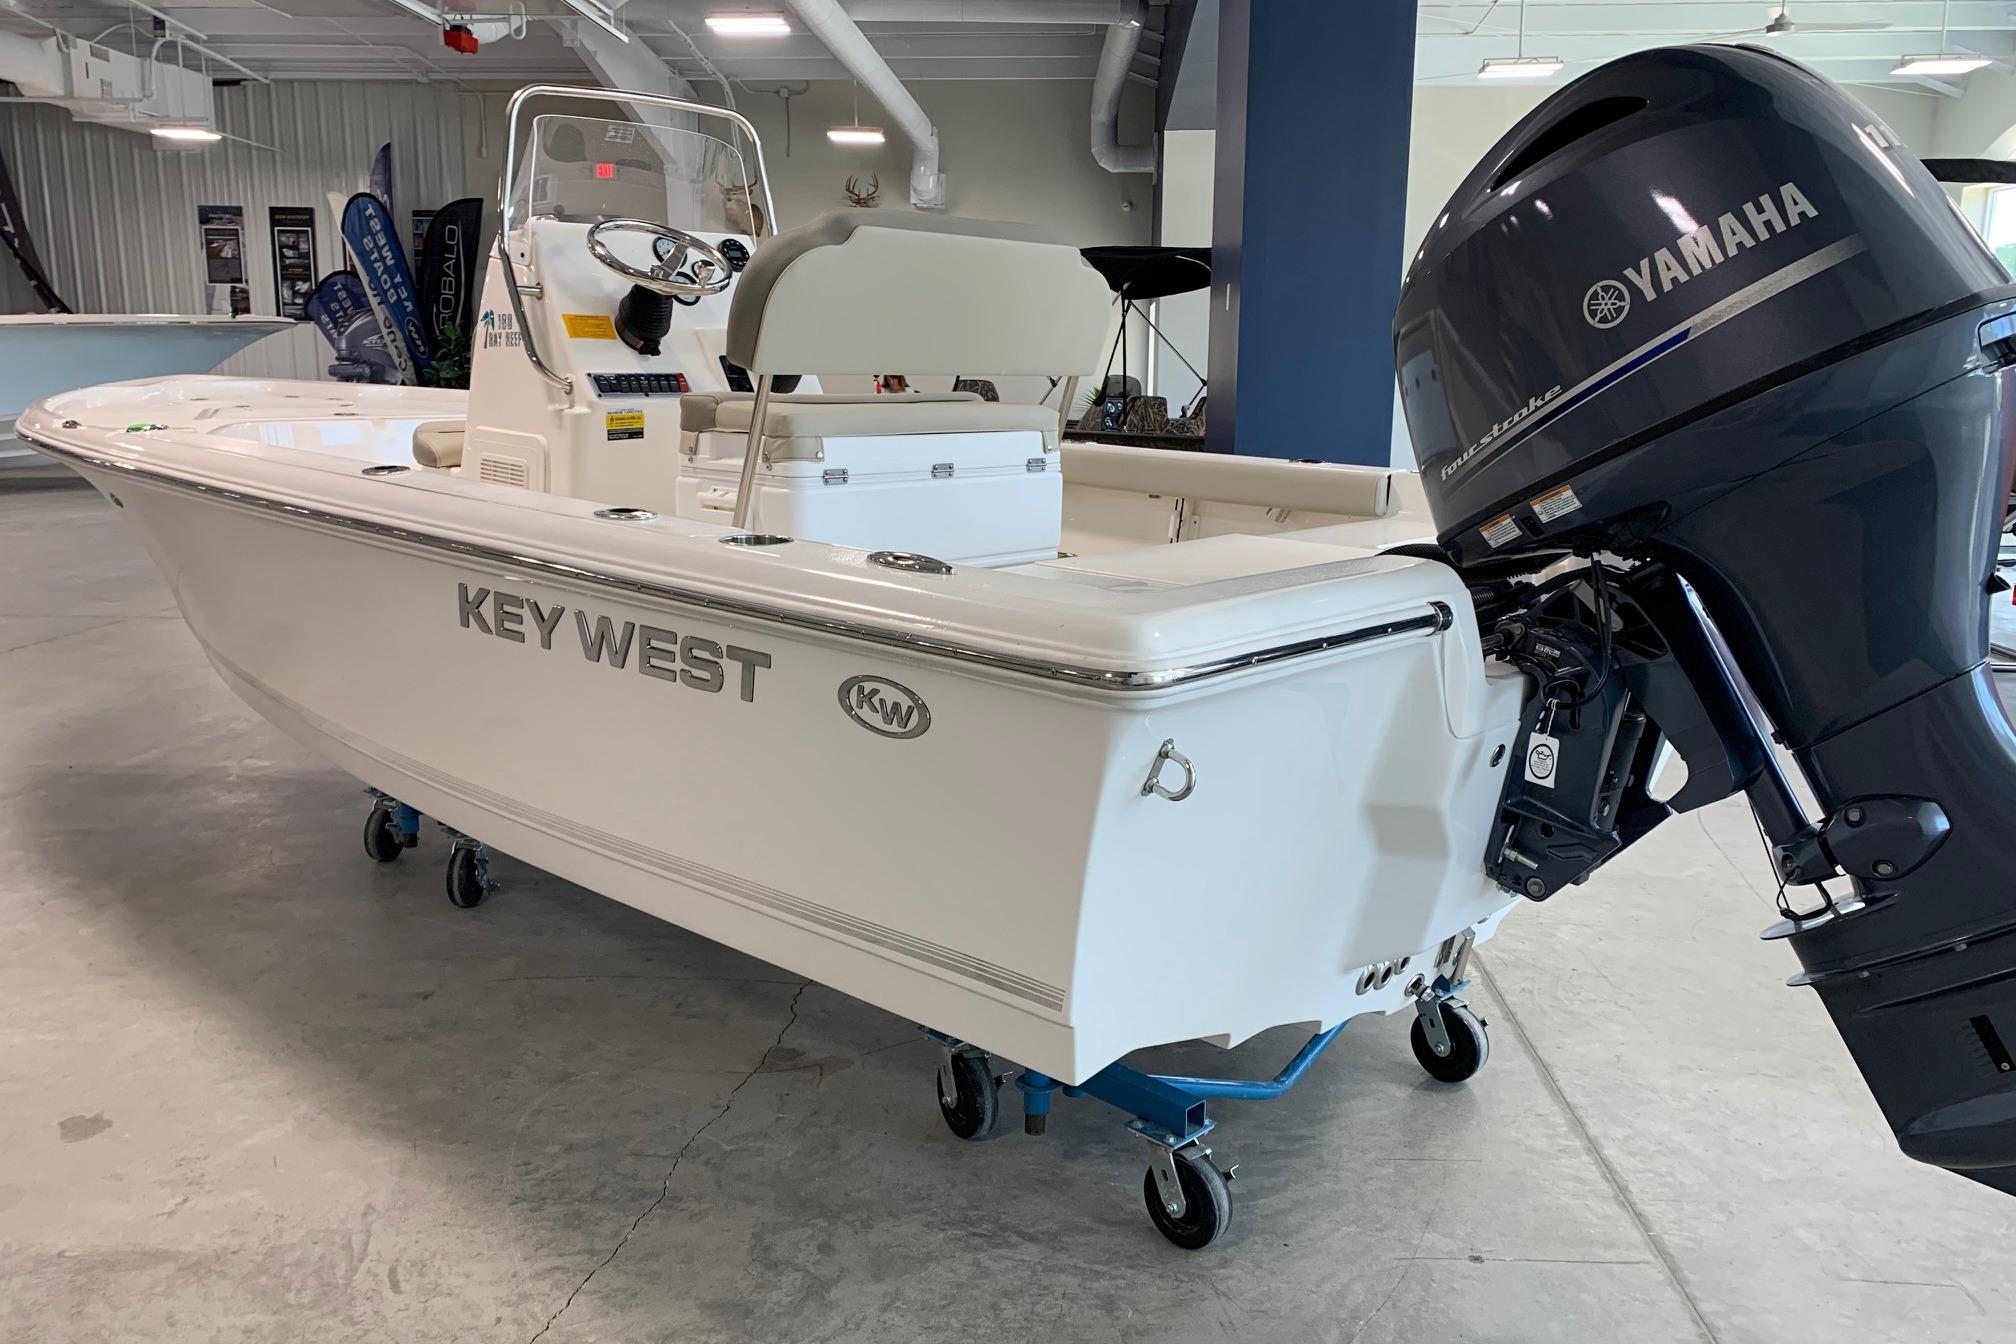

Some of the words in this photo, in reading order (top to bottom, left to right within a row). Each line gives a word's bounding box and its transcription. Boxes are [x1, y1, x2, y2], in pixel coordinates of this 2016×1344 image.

[439, 225, 459, 330] ROBALO
[1622, 181, 1819, 302] YAMAHA
[489, 332, 503, 347] BAY
[505, 331, 522, 347] REEF
[1477, 384, 1564, 450] stroke
[458, 582, 565, 651] KEY
[573, 608, 772, 703] WEST
[856, 684, 915, 729] KW
